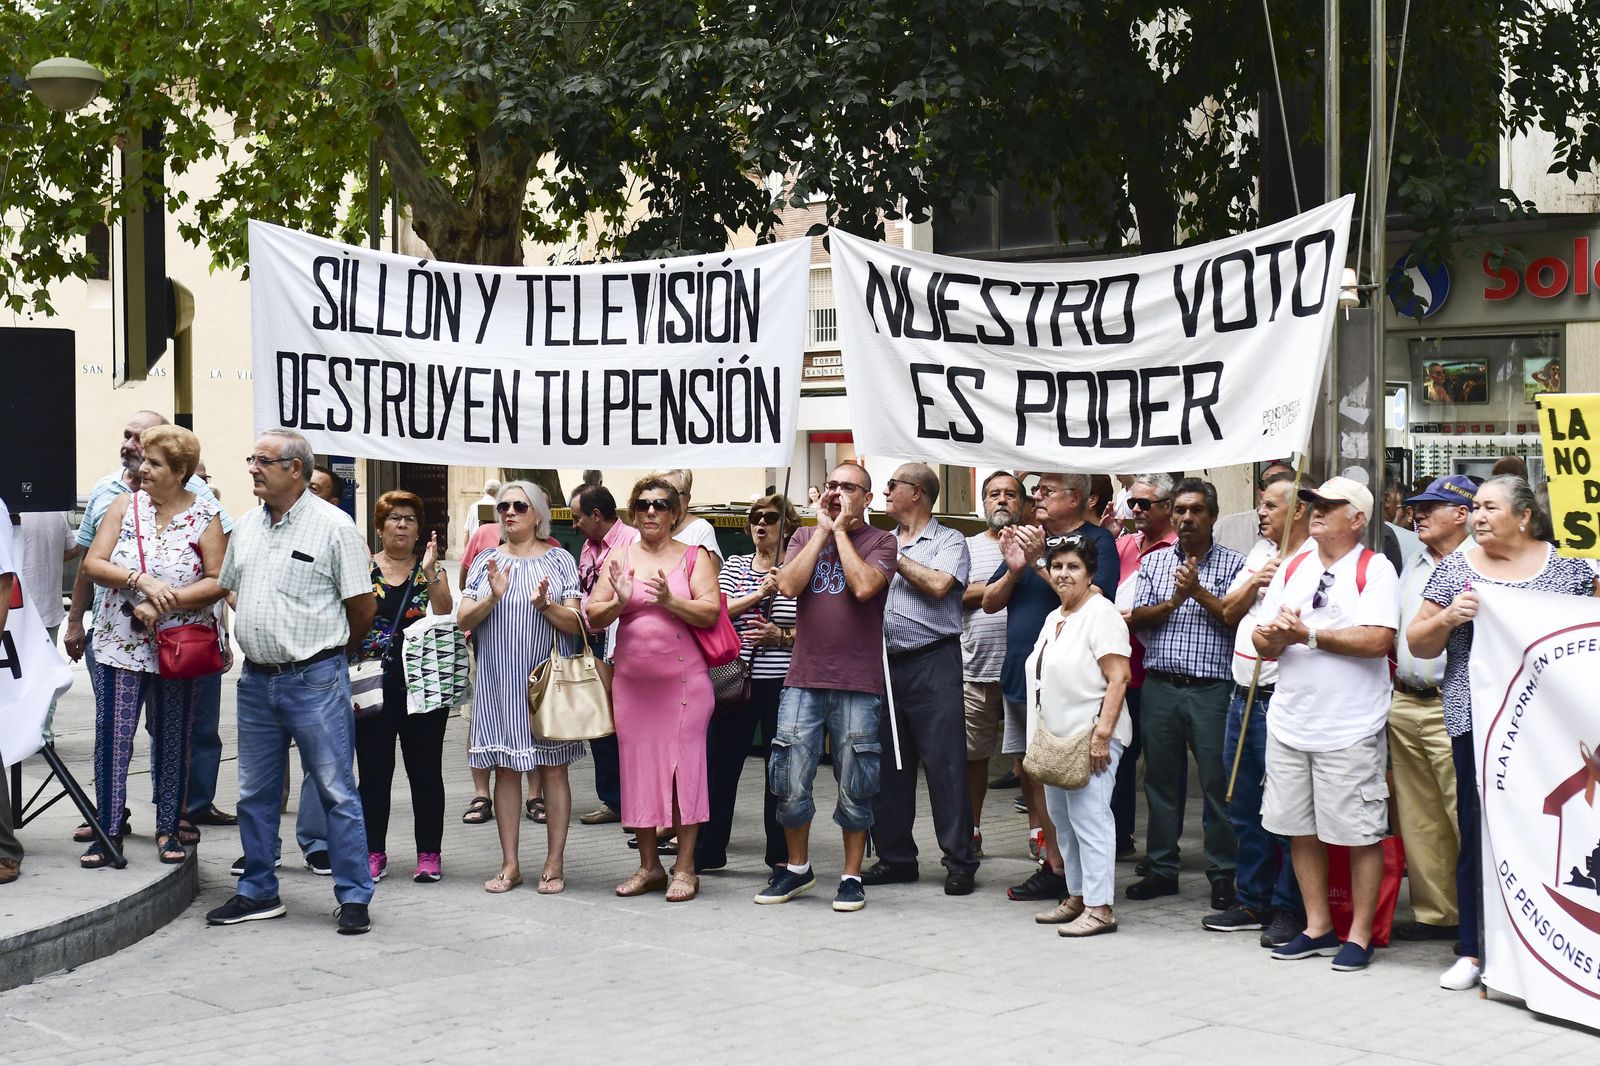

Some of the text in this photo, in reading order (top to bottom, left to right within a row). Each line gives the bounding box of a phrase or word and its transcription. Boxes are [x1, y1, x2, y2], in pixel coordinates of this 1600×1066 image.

[866, 229, 1336, 348] NUESTRO VOTO
[1483, 237, 1600, 300] Sol
[475, 272, 501, 345] Y
[82, 365, 104, 375] SAN
[210, 369, 223, 379] LA
[276, 351, 520, 444] DESTRUYEN
[535, 369, 589, 446] TU
[910, 361, 1224, 449] ES PODER
[1548, 408, 1591, 441] LA
[1553, 446, 1592, 475] NO
[1563, 511, 1600, 550] S
[811, 560, 846, 594] 85
[1497, 673, 1540, 790] PLATAFORMA
[1554, 638, 1600, 660] DEFE
[1499, 860, 1593, 974] DE PENSIONES
